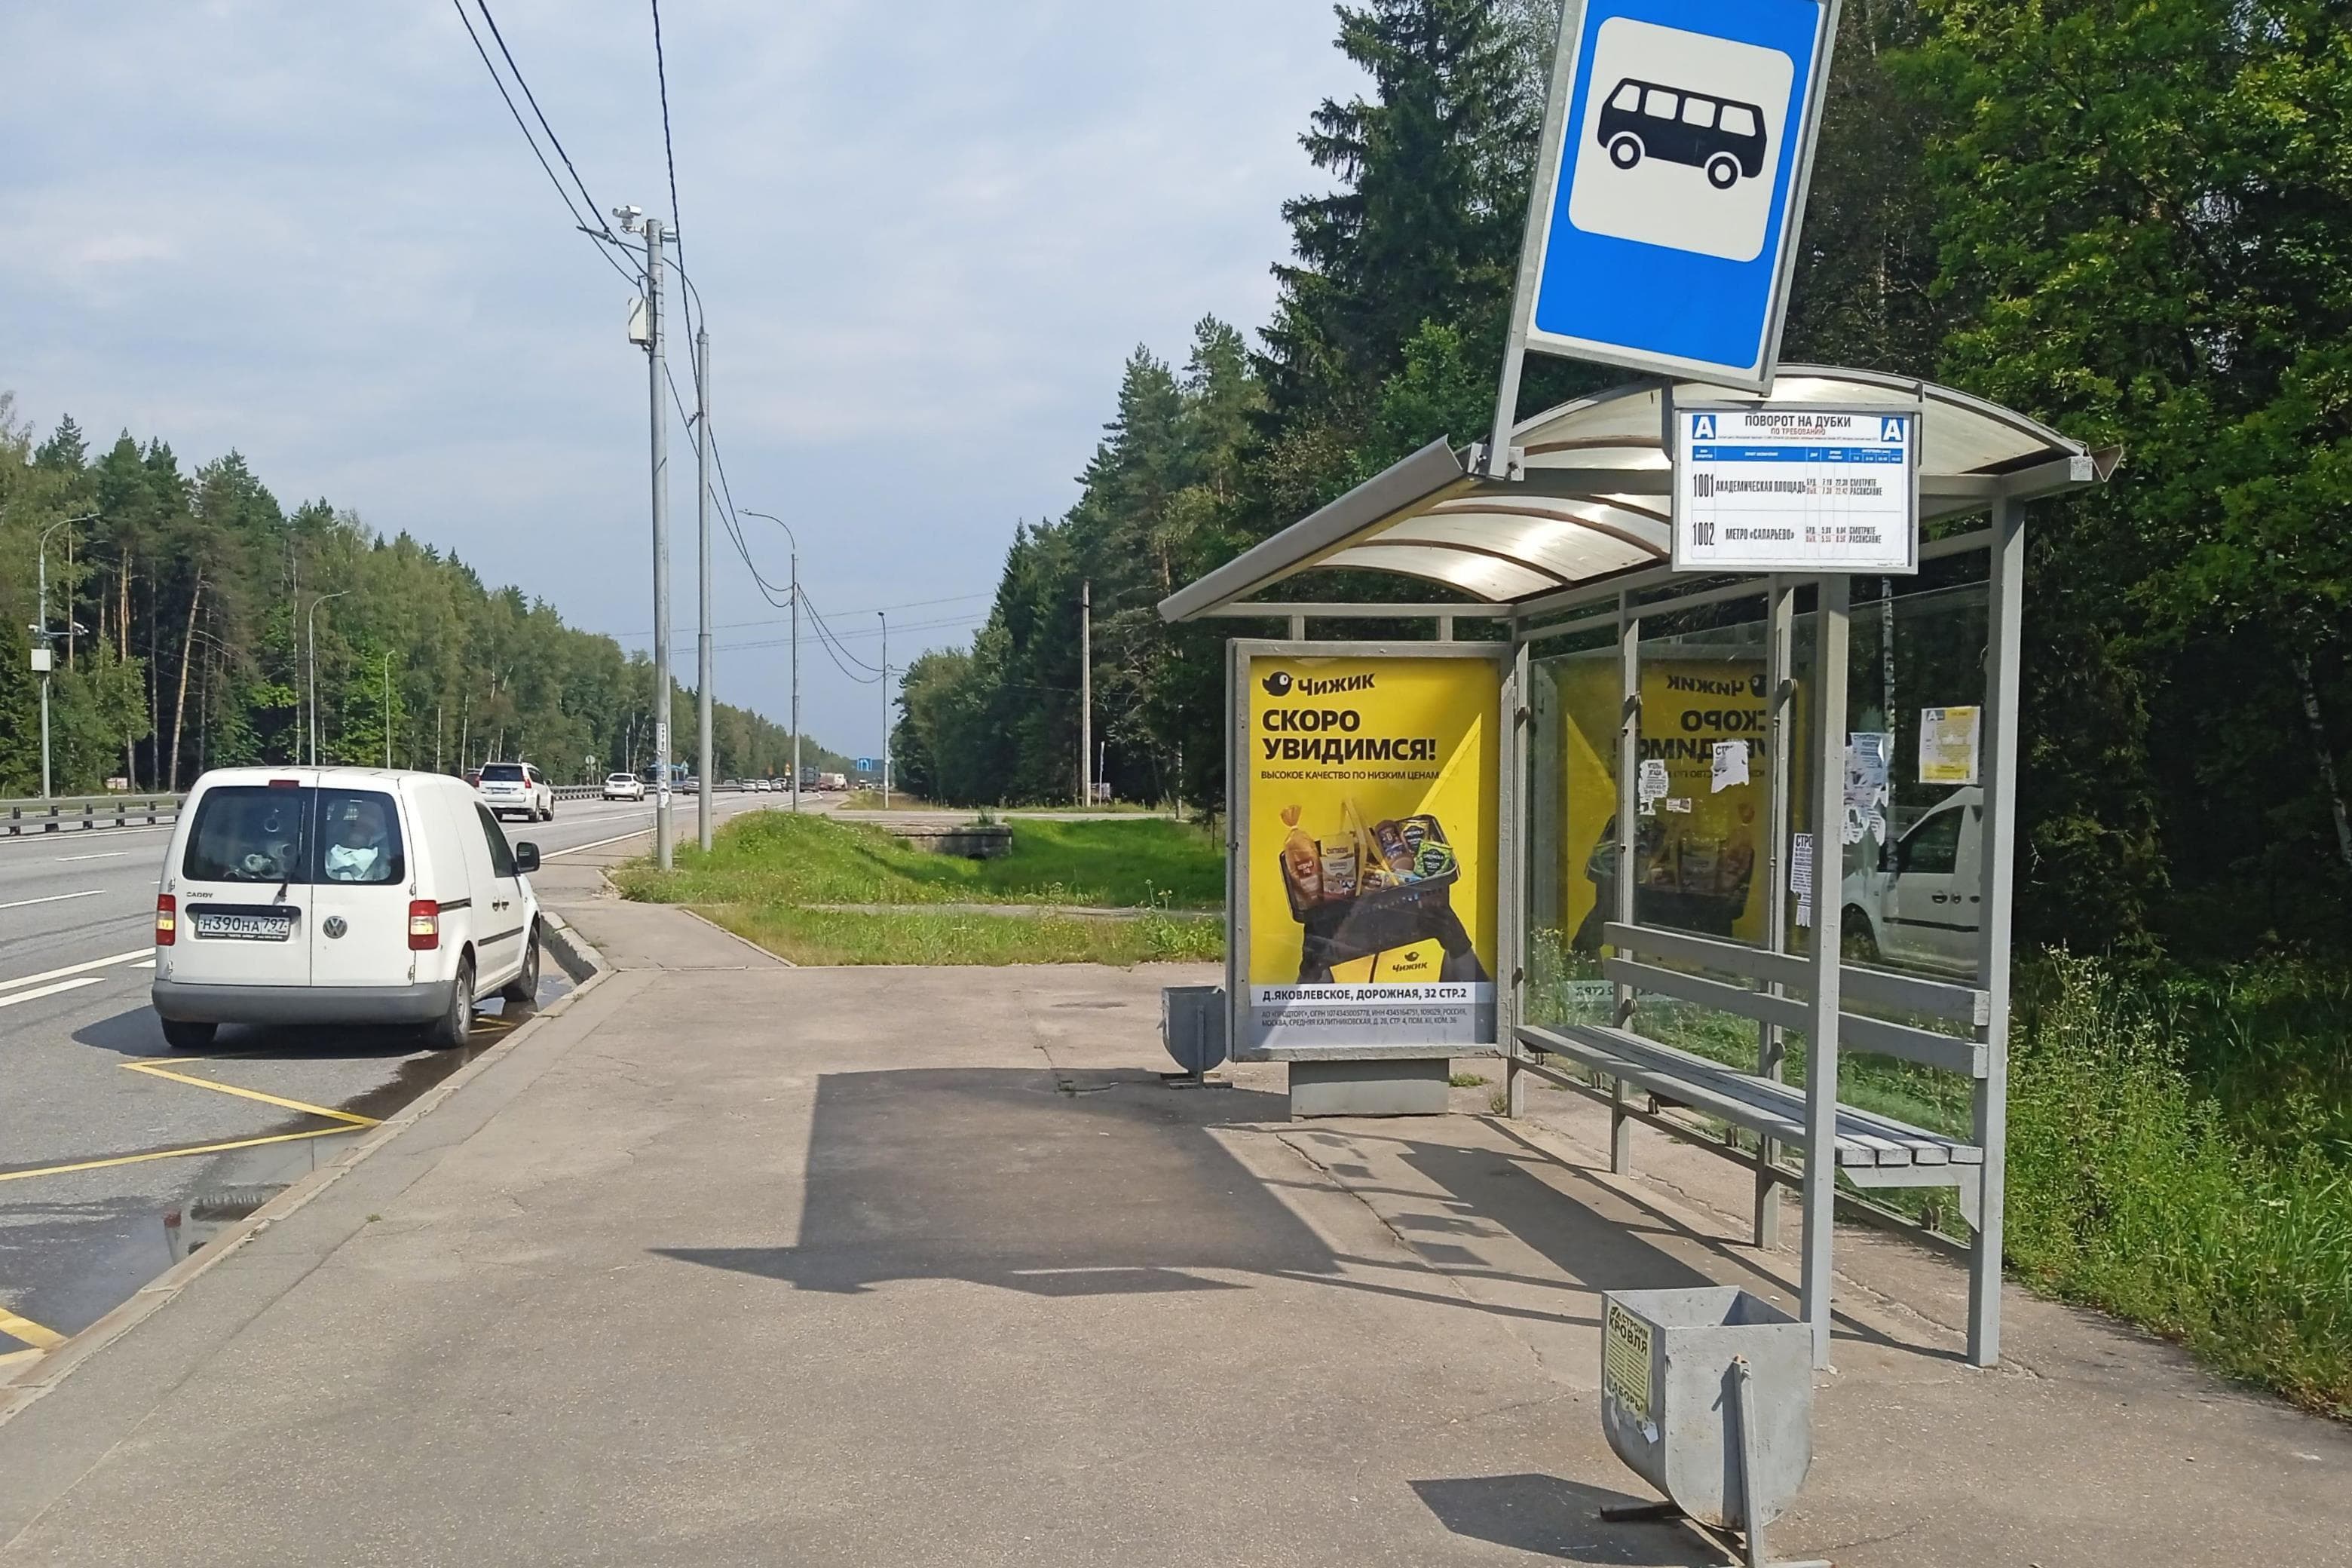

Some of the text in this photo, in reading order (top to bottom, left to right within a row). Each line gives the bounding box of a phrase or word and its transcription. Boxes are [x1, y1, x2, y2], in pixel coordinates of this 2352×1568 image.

[1745, 415, 1851, 429] ПОВОРОТ НА ДУБКИ
[1783, 427, 1826, 436] ТРЕБОВАНИЮ
[1693, 473, 1805, 498] 1001 АКАДЕМИЧЕСКАЯ ПЛОЩАДЬ
[1850, 478, 1877, 486] СМОТРИТЕ
[1850, 487, 1882, 495] РАСПИСАНИЕ
[1693, 522, 1714, 546] 1002
[1726, 528, 1748, 540] МЕТРО
[1849, 526, 1876, 534] СМОТРИТЕ
[1848, 534, 1882, 544] РАСПИСАНИЕ
[1262, 709, 1361, 732] СКОРО
[1262, 738, 1436, 764] УВИДИМСЯ!
[1261, 770, 1439, 780] ВЫСОКОЕ КАЧЕСТВО ПО НИЗКИМ ЦЕНАМ
[264, 918, 285, 929] 797
[1263, 988, 1467, 1002] Д.ЯКОВЛЕВСКОЕ, ДОРОЖНАЯ, 32 СТР.2
[1609, 1314, 1647, 1356] КРОВЛЯ
